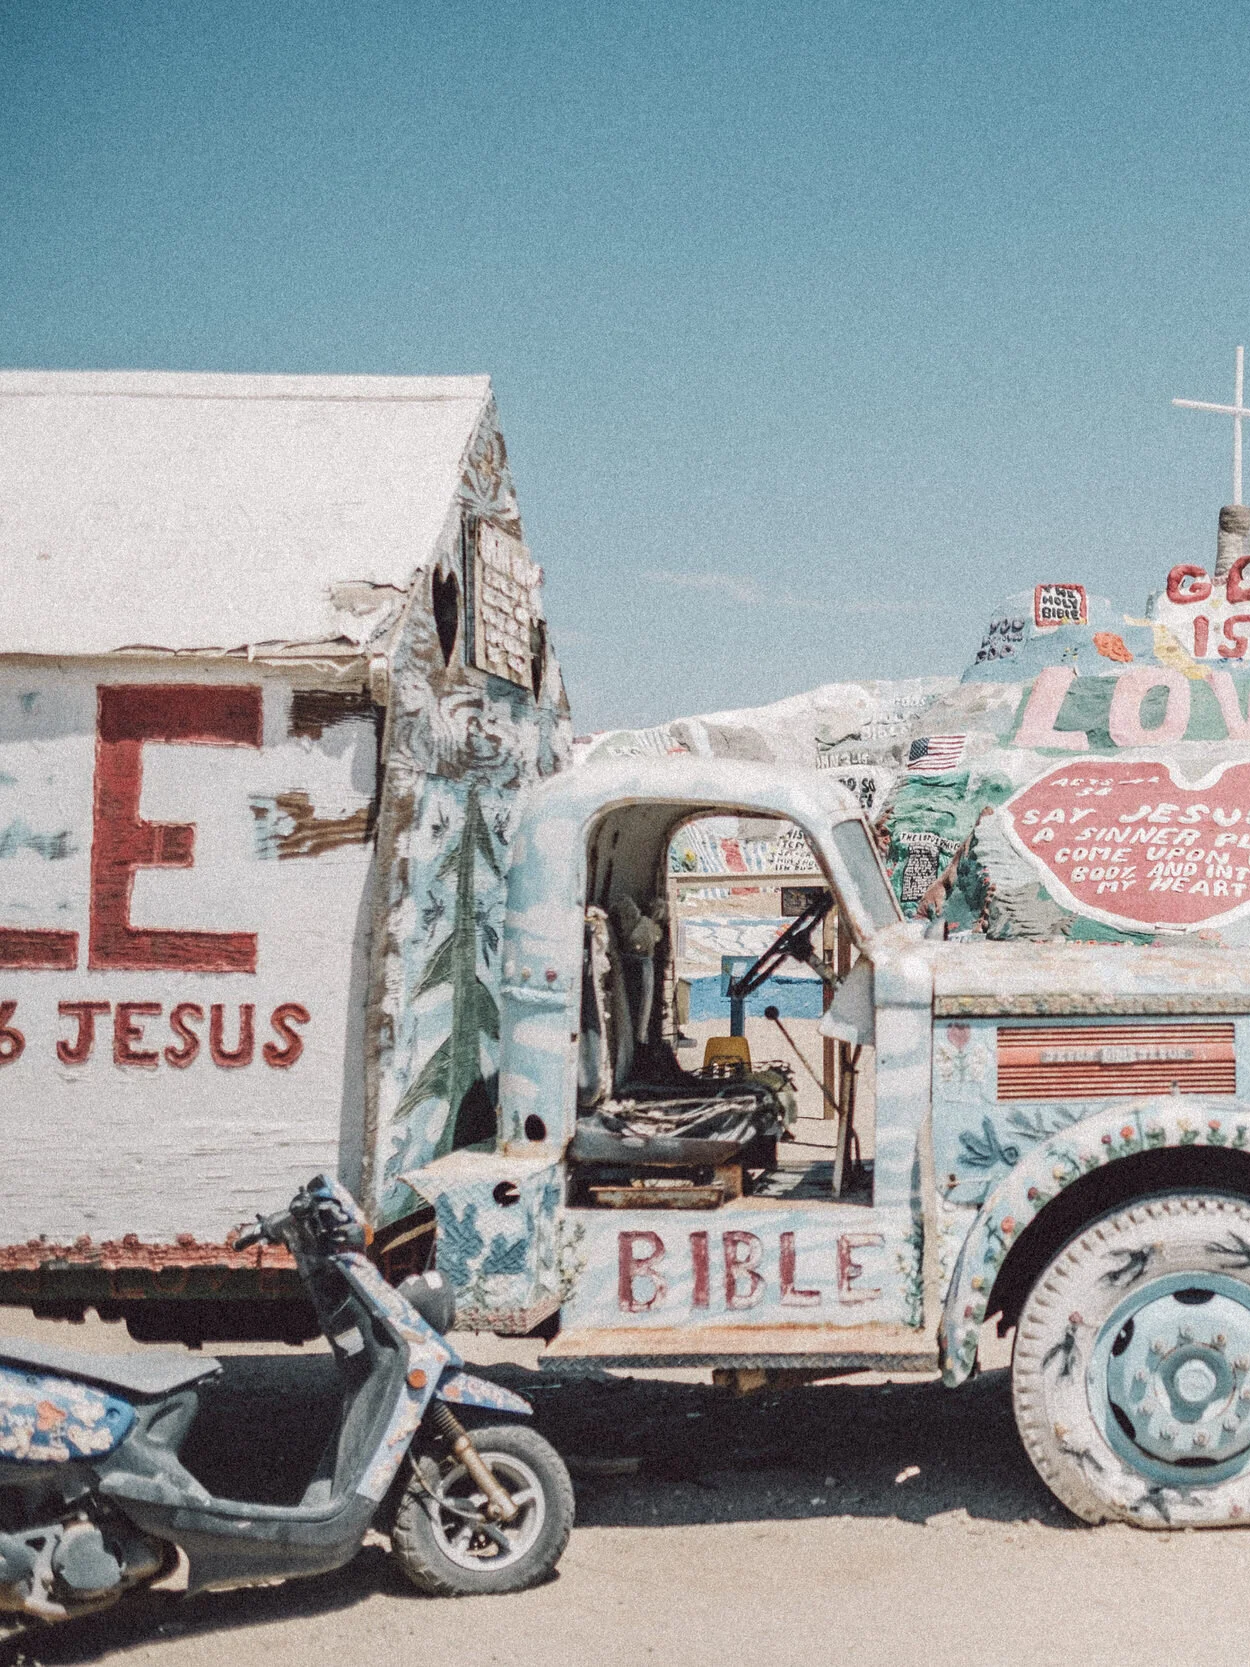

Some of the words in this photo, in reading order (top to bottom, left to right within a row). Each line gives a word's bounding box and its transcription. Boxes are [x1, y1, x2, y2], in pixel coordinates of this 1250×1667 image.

[1041, 606, 1080, 620] BIBLE
[1042, 595, 1078, 610] HOLY
[1021, 807, 1098, 826] SAY
[1031, 826, 1056, 845] A
[1074, 826, 1202, 847] SINNER
[1054, 847, 1133, 864] COME
[1145, 847, 1231, 866] UPON
[1070, 865, 1137, 884] BODY
[1148, 862, 1199, 879] AND
[1096, 879, 1137, 895] MY
[1148, 876, 1248, 897] HEART
[55, 999, 311, 1068] JESUS
[617, 1230, 886, 1313] BIBLE
